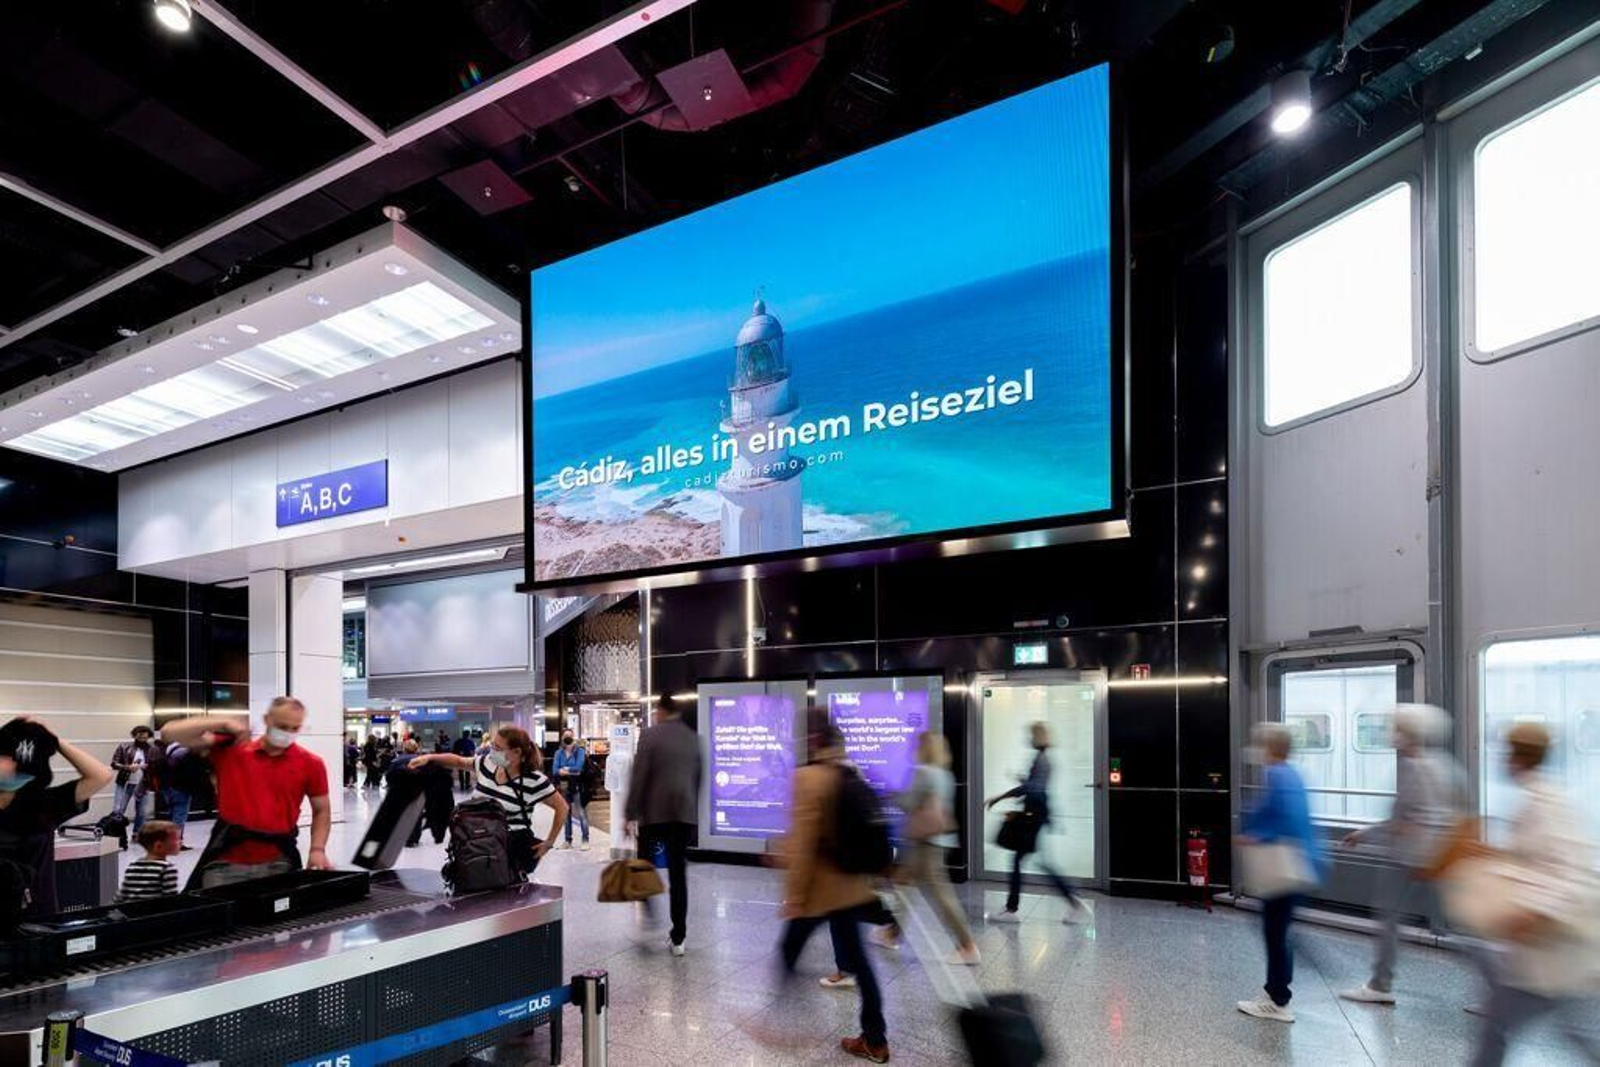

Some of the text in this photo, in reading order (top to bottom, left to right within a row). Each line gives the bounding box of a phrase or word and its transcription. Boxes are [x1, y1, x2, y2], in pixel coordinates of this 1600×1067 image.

[558, 368, 1034, 490] Cádiz, alles in einem Reiseziel
[300, 482, 352, 516] A,B,C
[867, 735, 878, 743] the
[529, 995, 551, 1013] DUS
